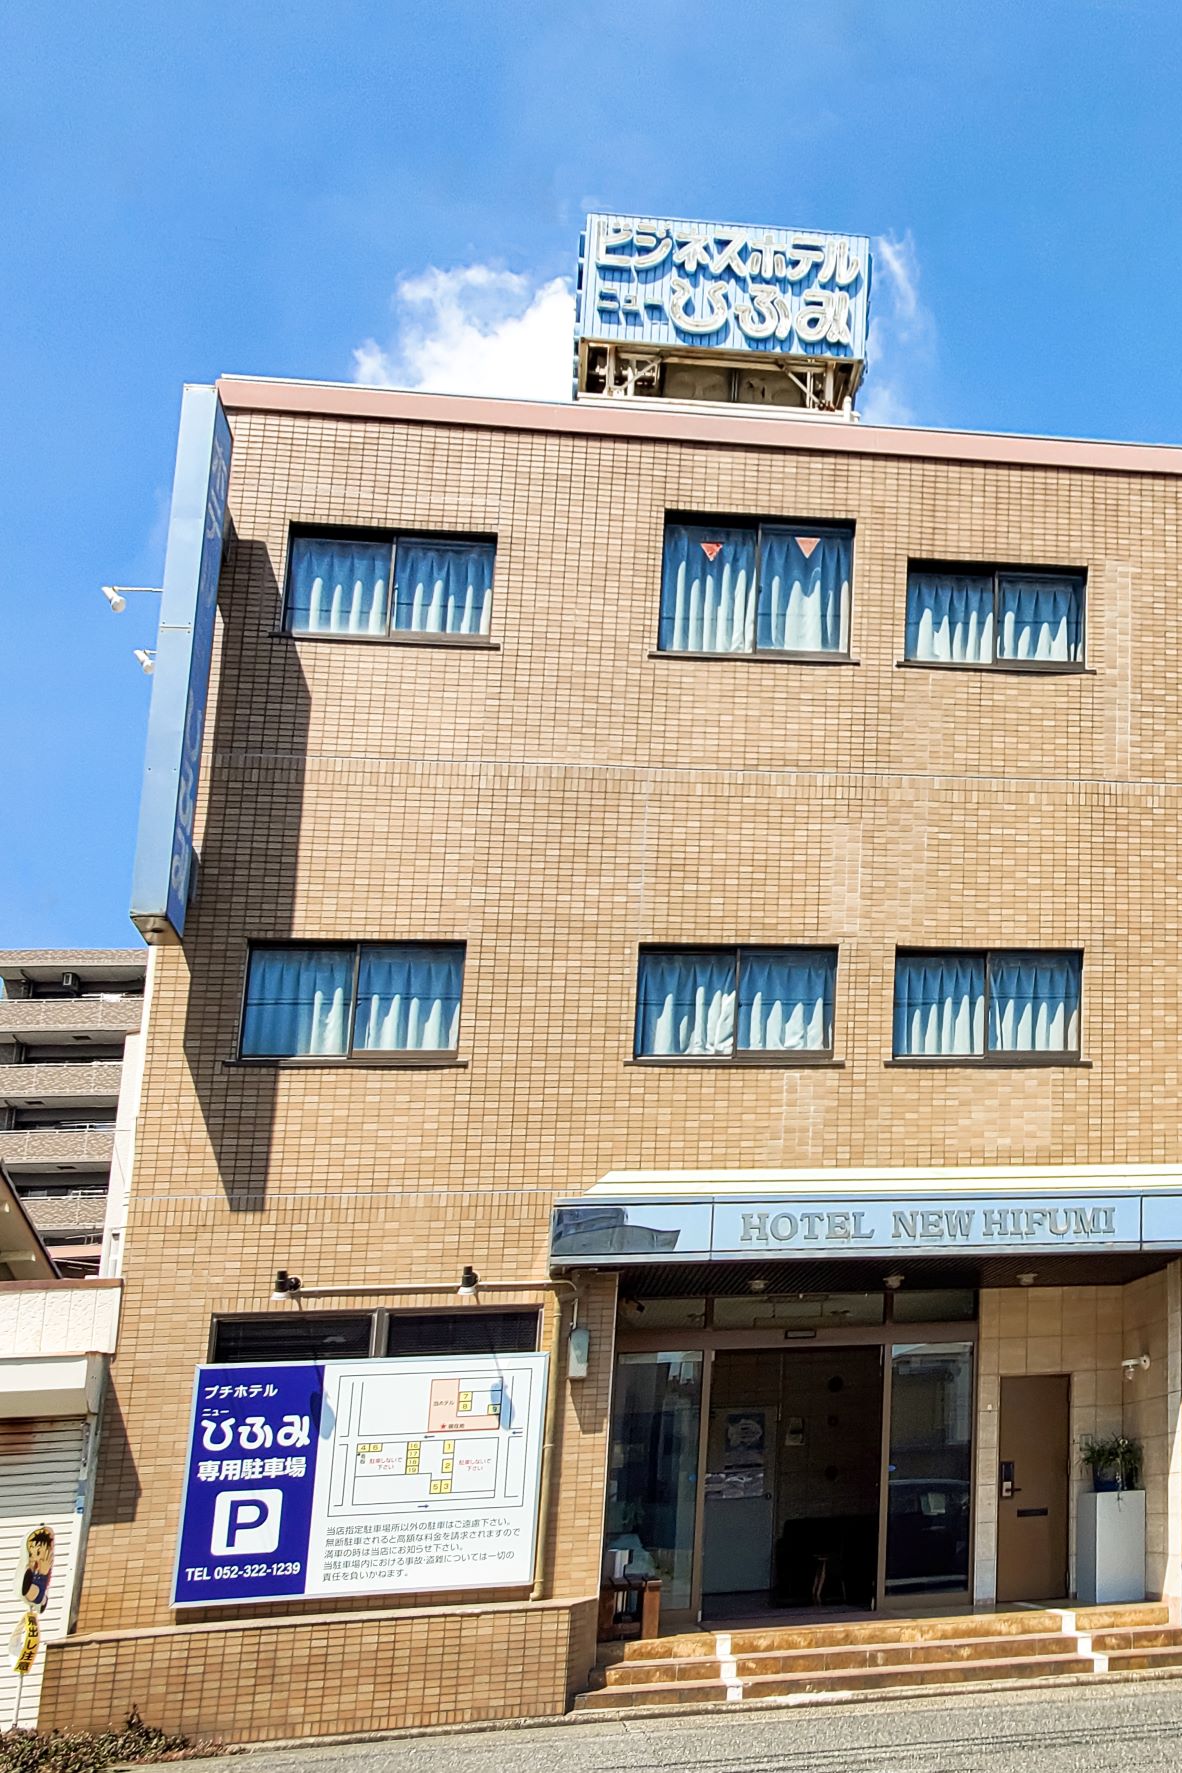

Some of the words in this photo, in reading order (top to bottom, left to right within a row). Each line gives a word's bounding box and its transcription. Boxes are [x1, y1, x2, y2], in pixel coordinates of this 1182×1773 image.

[596, 220, 860, 288] ビジネスホテル
[740, 1211, 875, 1242] HOTEL
[892, 1209, 975, 1239] NEW
[982, 1206, 1116, 1237] HIFUMI
[204, 1383, 278, 1399] プチホテル
[202, 1408, 230, 1416] ニュー
[201, 1414, 311, 1451] ひふみ
[197, 1456, 307, 1481] 専用駐車場
[226, 1499, 269, 1548] P
[324, 1543, 464, 1559] 満車の時は当店にお知らせ下さい。
[185, 1567, 211, 1581] TEL
[214, 1561, 301, 1580] 052-322-1239
[322, 1568, 409, 1583] 責任を負いかねます。
